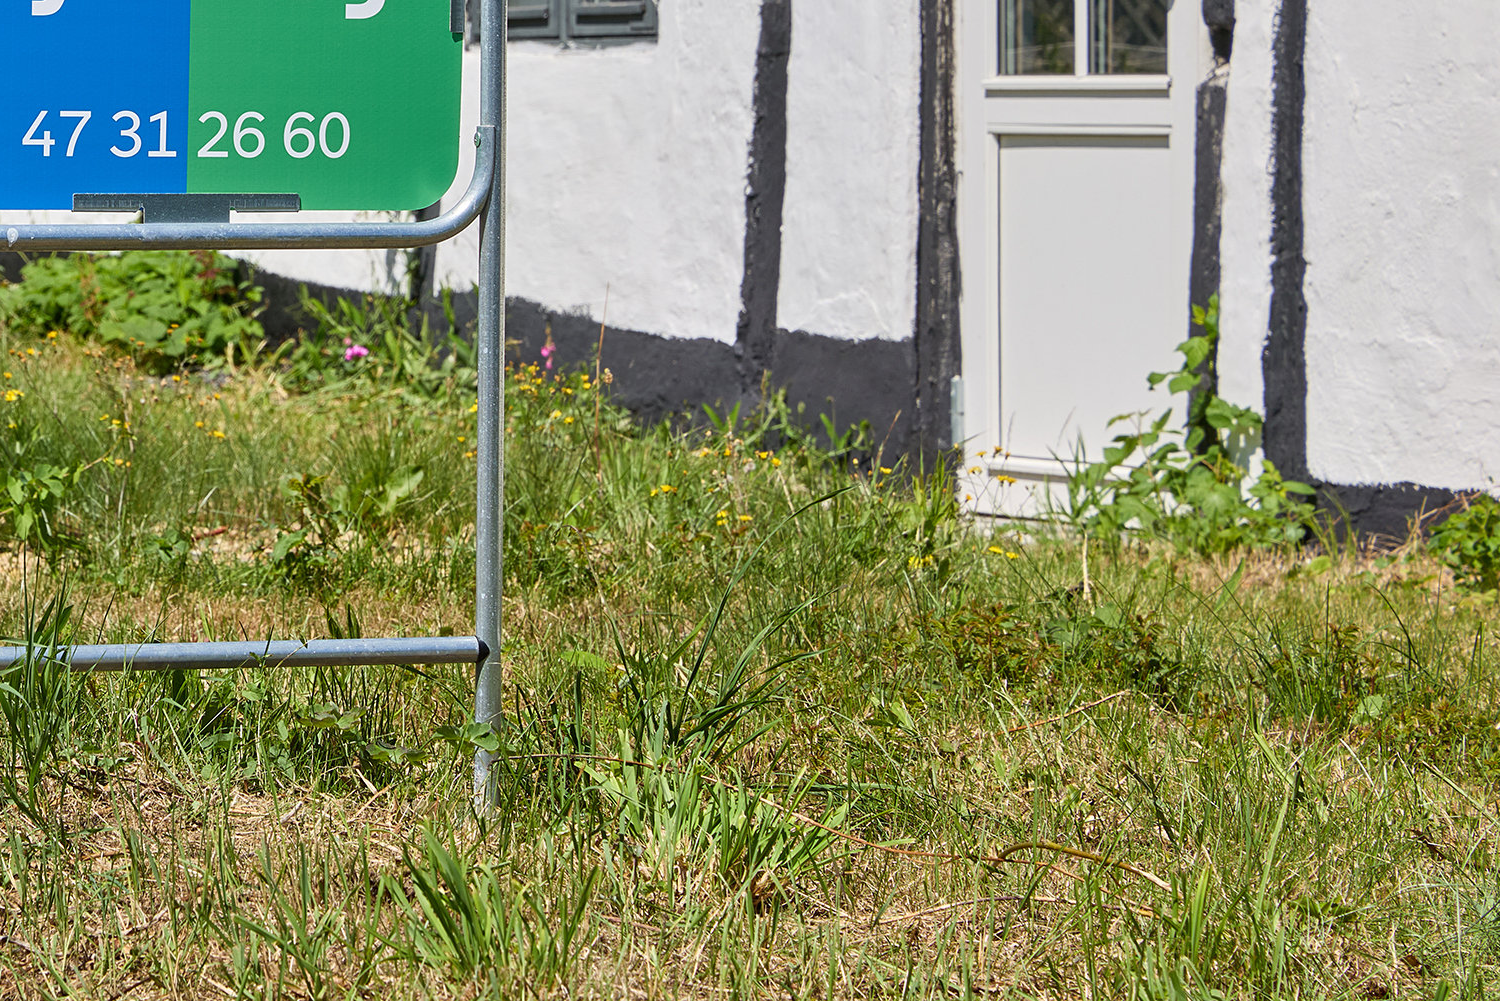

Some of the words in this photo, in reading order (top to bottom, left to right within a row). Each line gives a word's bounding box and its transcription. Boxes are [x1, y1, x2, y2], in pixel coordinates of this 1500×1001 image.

[21, 110, 91, 157] 47
[109, 110, 177, 158] 31
[197, 110, 266, 158] 26
[283, 111, 351, 159] 60
